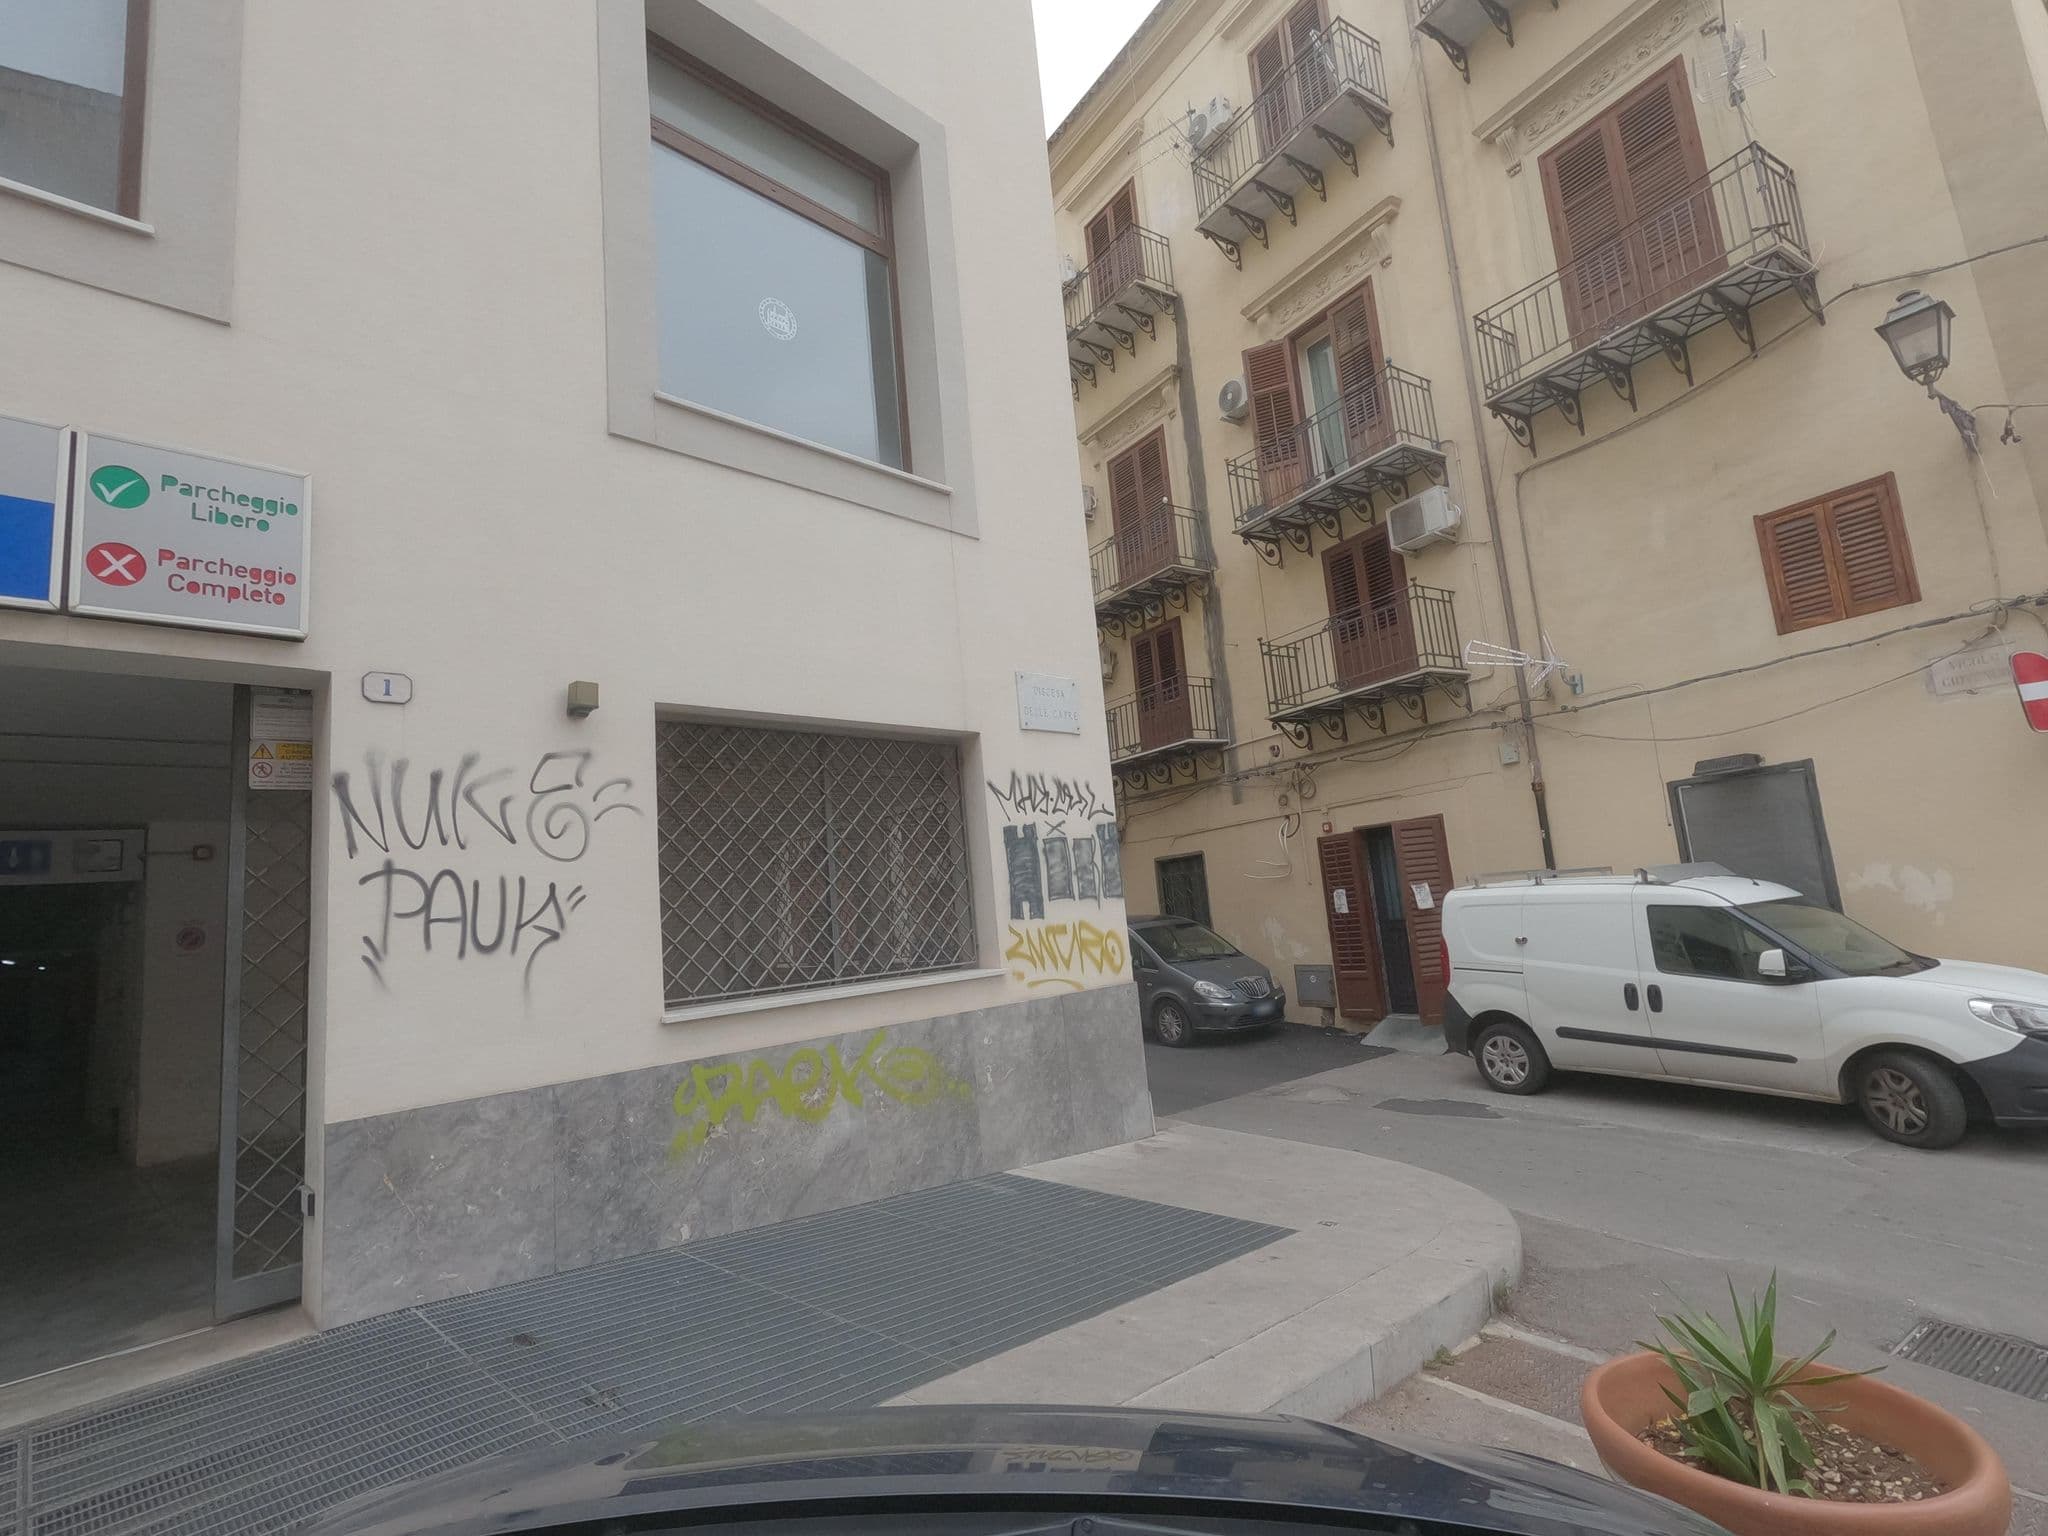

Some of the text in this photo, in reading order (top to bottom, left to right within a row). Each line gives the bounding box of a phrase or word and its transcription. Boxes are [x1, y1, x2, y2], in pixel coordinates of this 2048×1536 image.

[160, 473, 298, 516] Parcheggio
[191, 502, 270, 532] Libero
[157, 548, 297, 587] Parcheggio
[167, 573, 286, 606] Completo
[382, 678, 393, 697] 1
